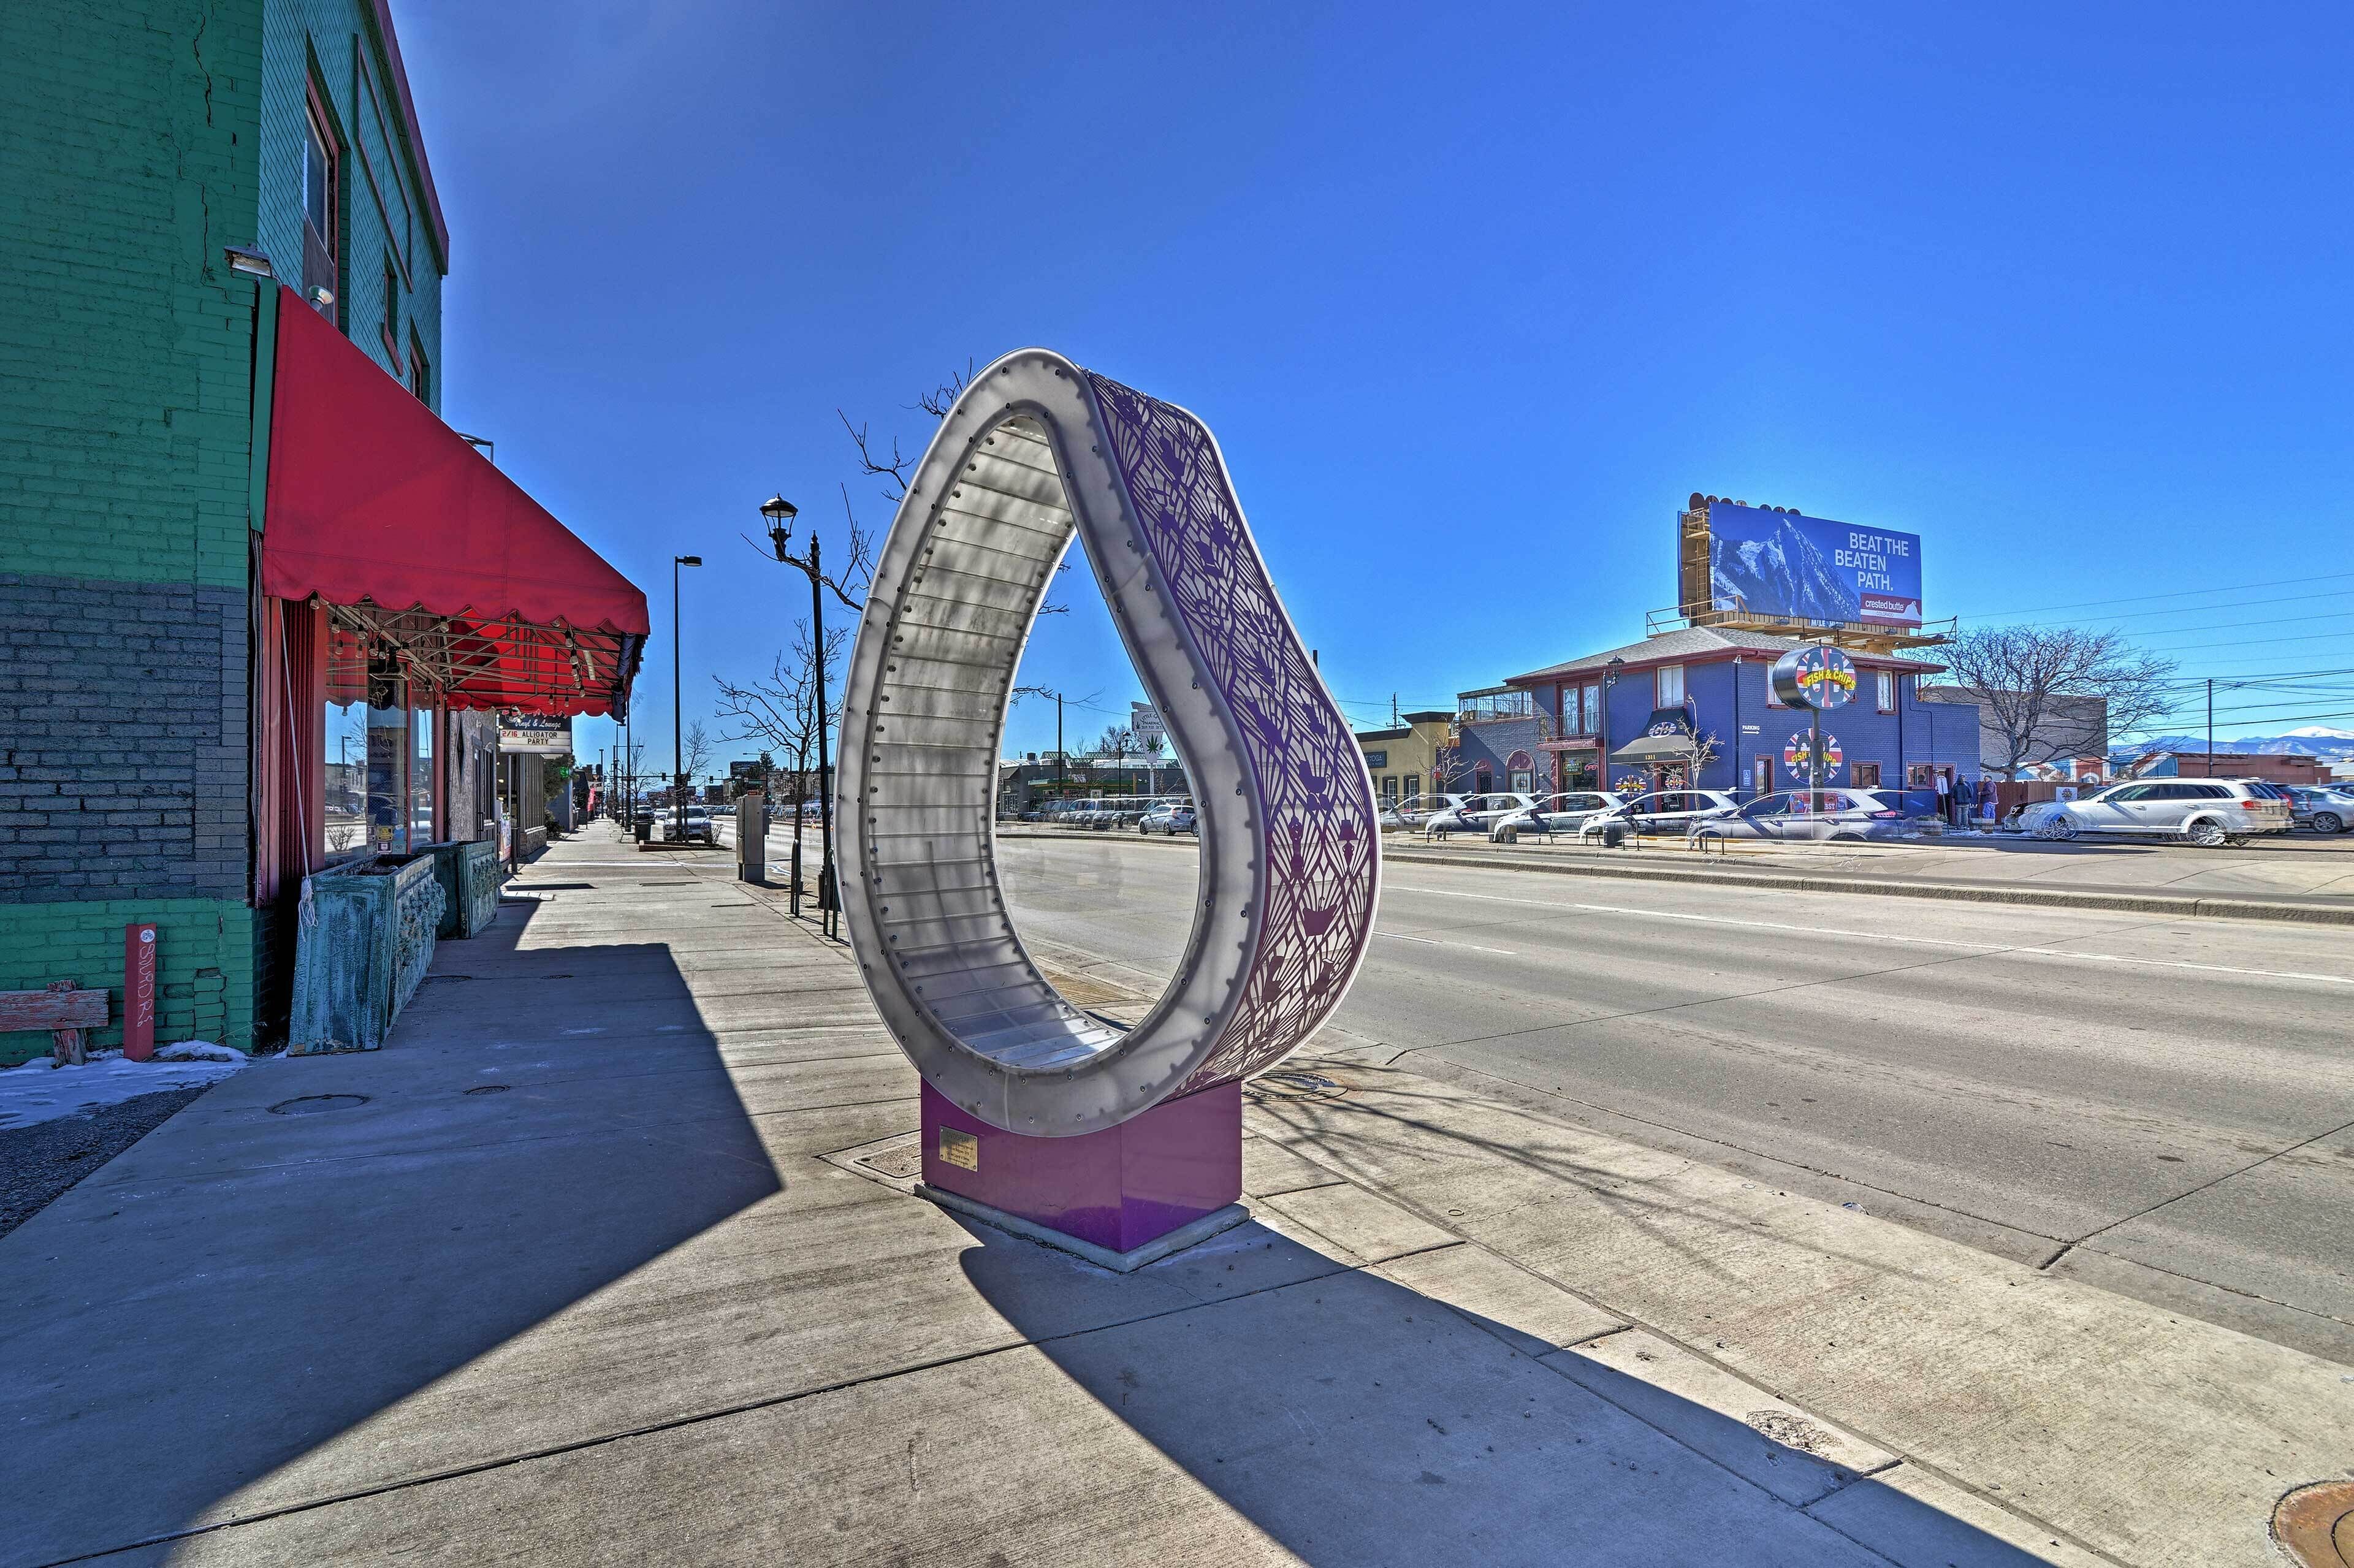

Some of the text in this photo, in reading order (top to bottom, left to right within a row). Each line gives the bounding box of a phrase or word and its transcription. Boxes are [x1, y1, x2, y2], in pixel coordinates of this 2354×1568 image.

[1849, 532, 1909, 557] BEAT THE
[1835, 549, 1886, 572] BEATEN
[1857, 571, 1894, 592] PATH.
[1865, 600, 1903, 611] crested butte
[1807, 669, 1856, 689] FISH & CHIPS
[539, 719, 561, 729] Lounge
[1140, 713, 1152, 723] LITTLE
[1791, 751, 1807, 764] FISH
